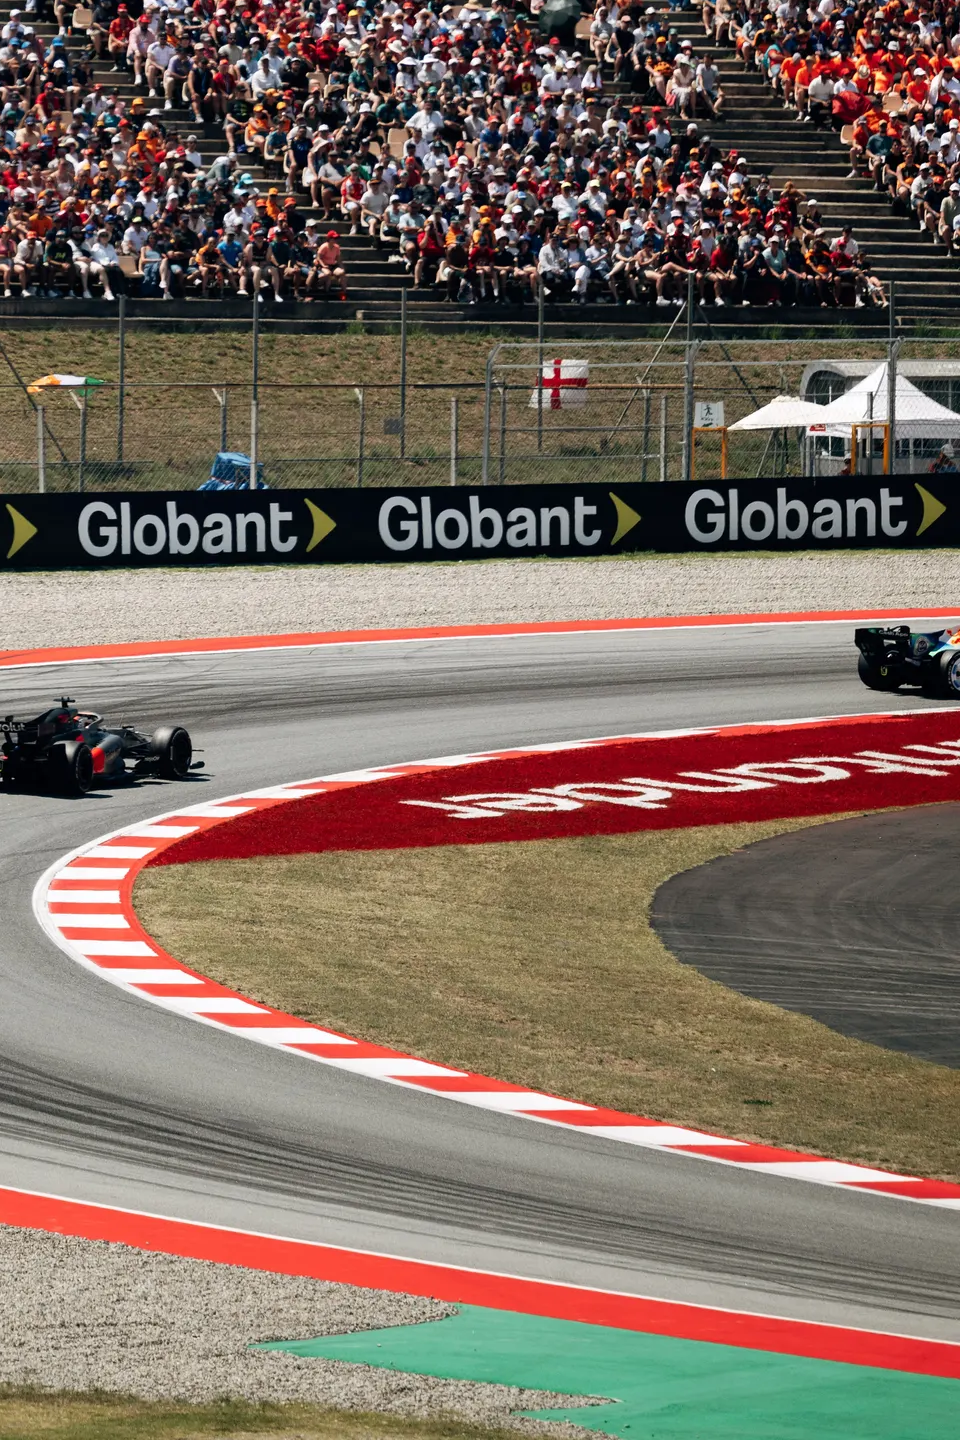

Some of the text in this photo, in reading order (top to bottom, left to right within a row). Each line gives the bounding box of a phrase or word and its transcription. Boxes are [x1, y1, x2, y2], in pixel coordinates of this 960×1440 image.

[78, 500, 298, 556] Globant
[379, 495, 602, 551] Globant
[685, 487, 908, 543] Globant
[399, 738, 960, 820] ntander
